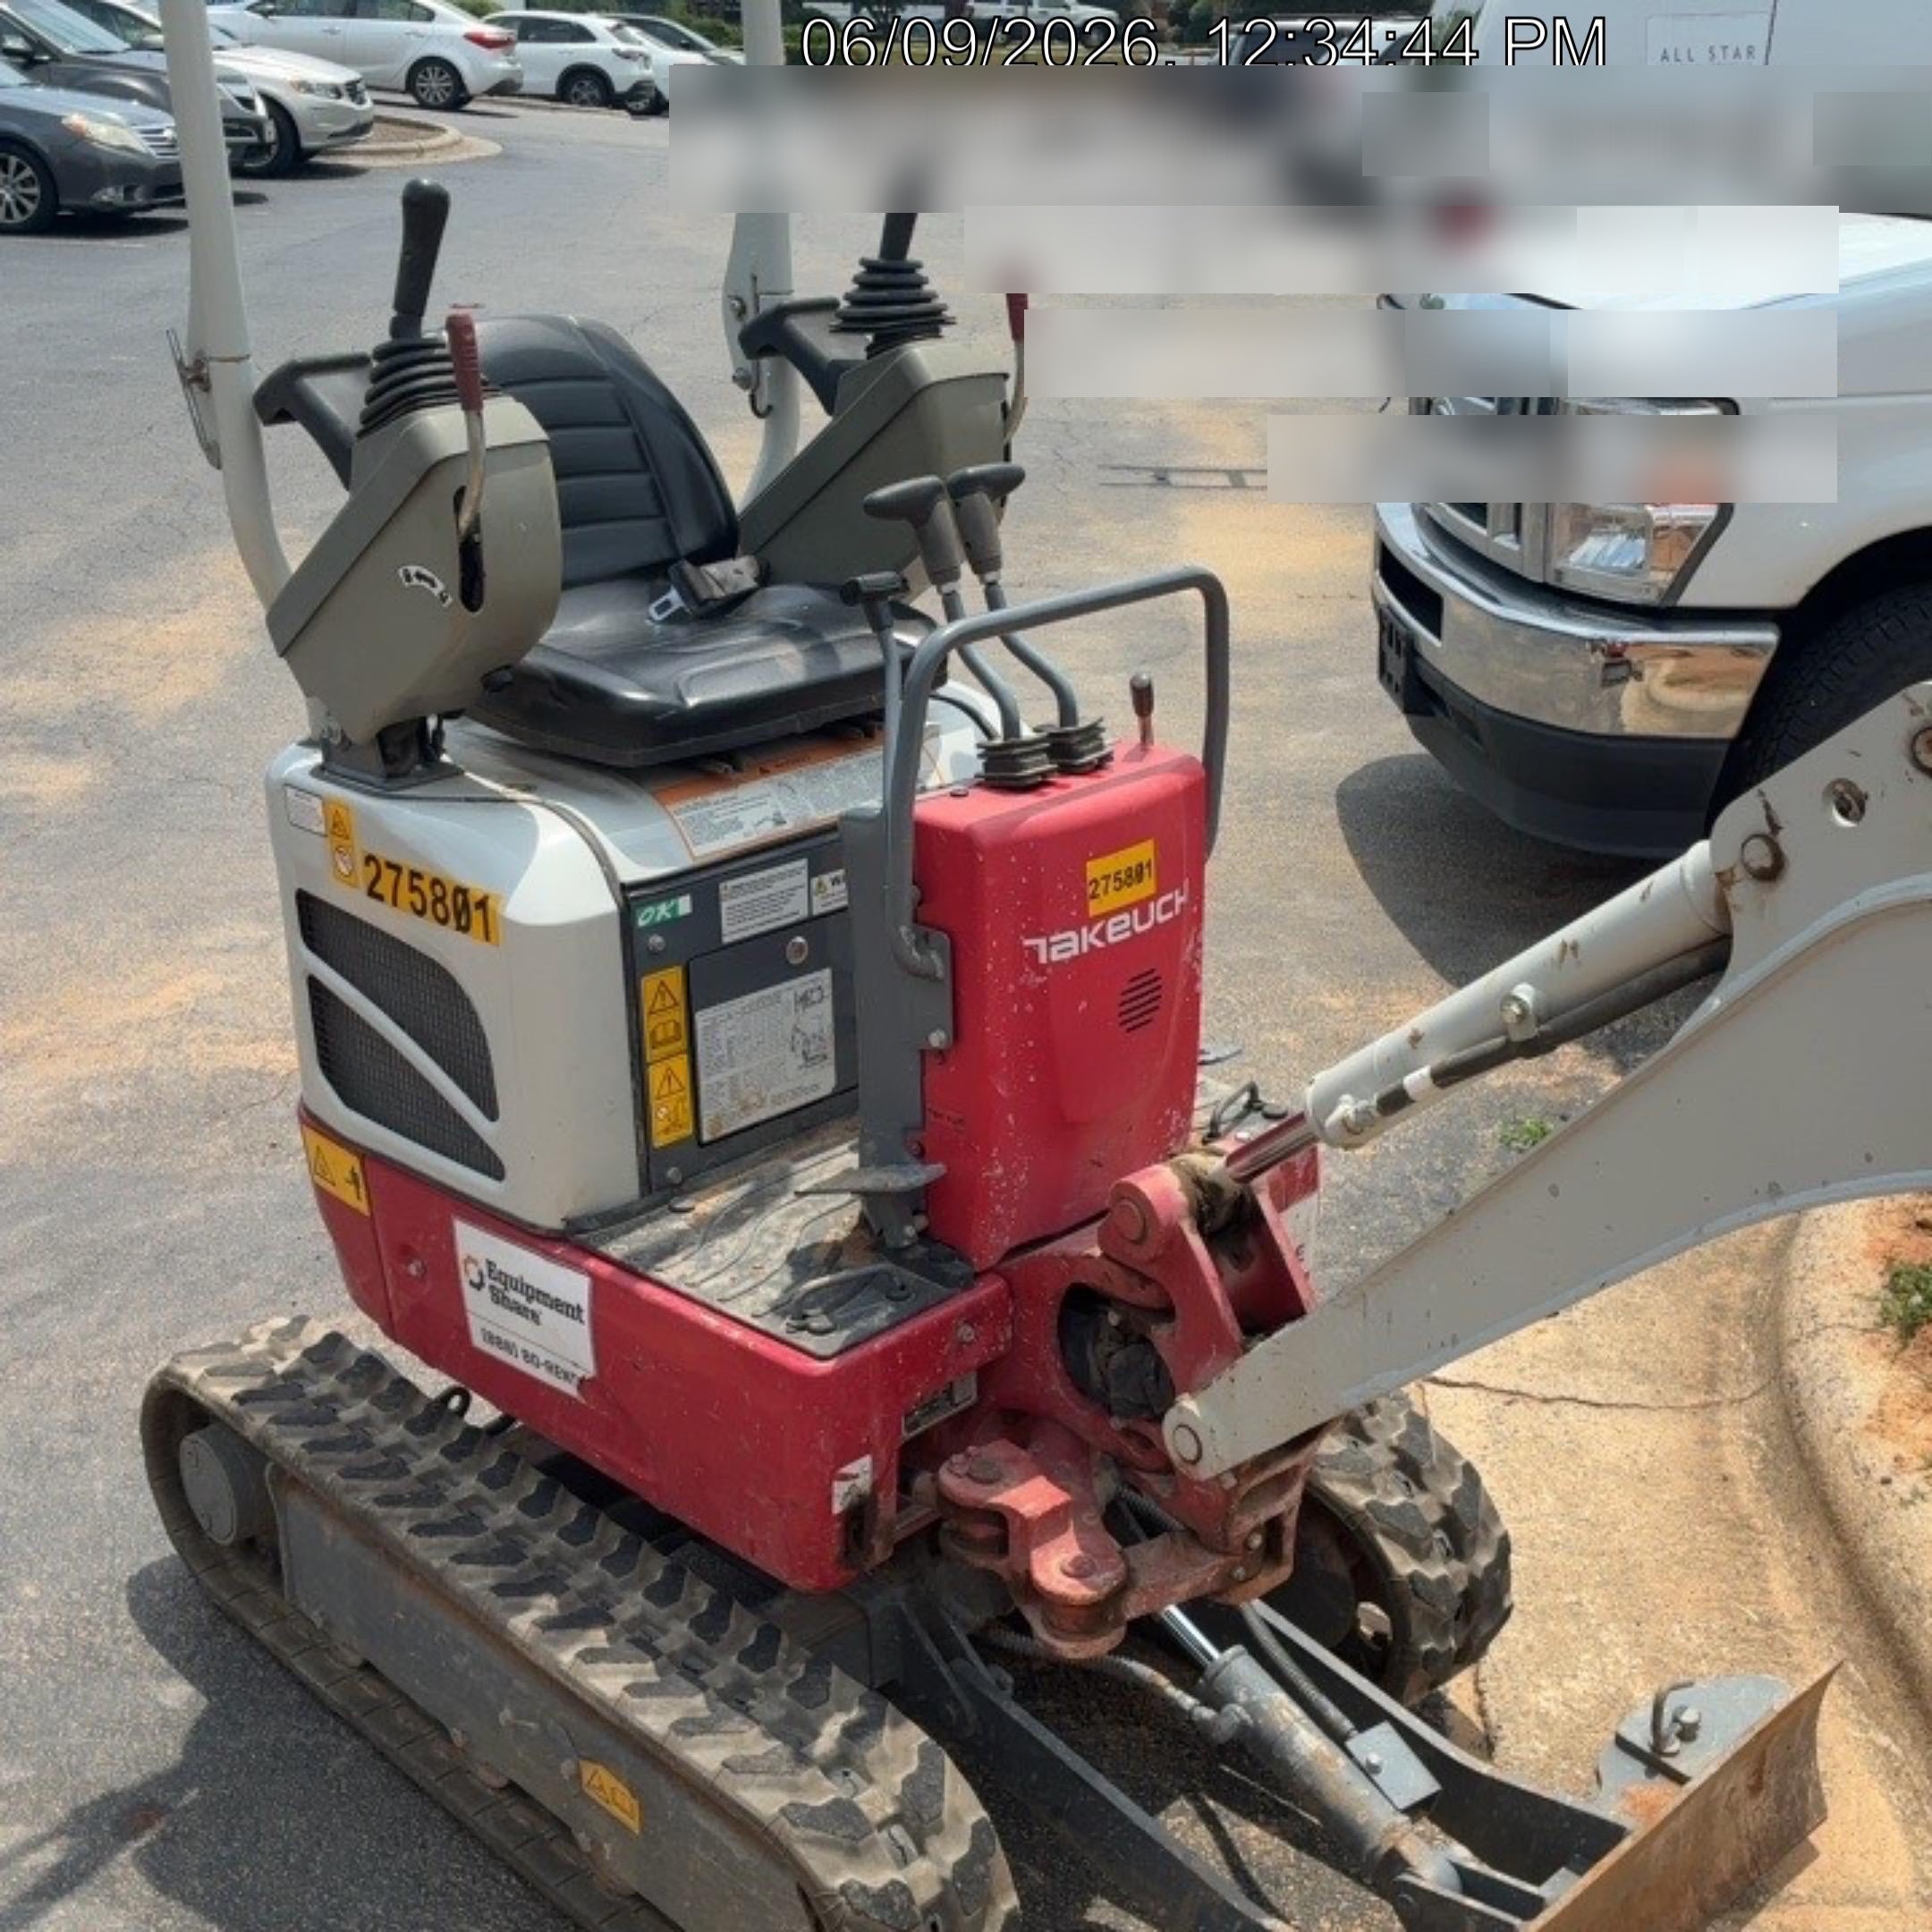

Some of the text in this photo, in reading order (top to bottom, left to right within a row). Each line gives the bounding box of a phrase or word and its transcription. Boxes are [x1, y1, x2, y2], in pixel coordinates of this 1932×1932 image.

[1660, 45, 1756, 63] ALL STAR
[364, 853, 491, 942] 275801
[1089, 858, 1151, 900] 275801
[486, 1258, 585, 1325] Equipment
